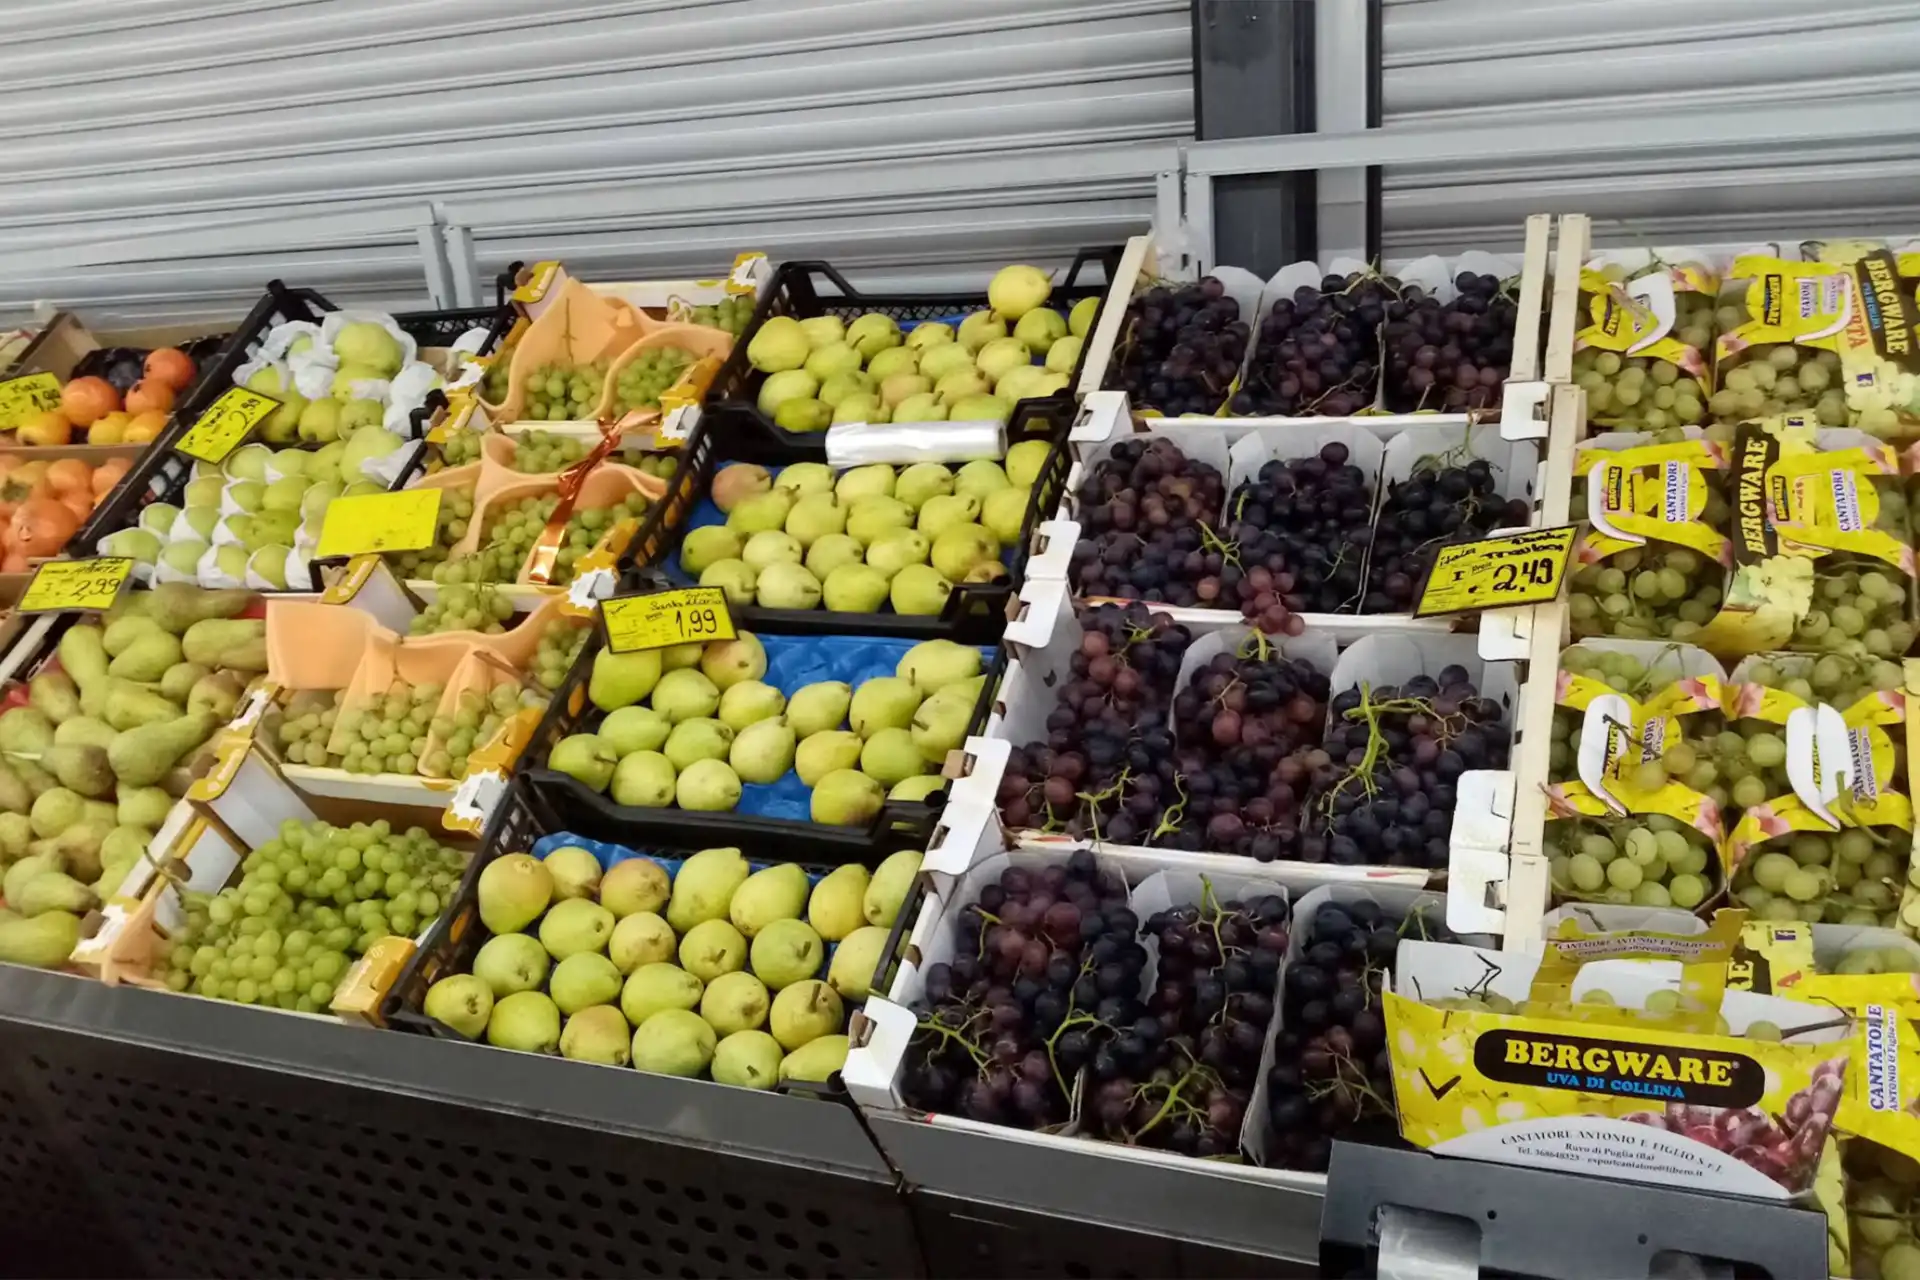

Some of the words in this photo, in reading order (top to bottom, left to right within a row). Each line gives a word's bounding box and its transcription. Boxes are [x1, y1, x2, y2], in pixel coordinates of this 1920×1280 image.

[1864, 259, 1910, 356] BERGWARE
[1666, 461, 1678, 522] CANTATORE
[1740, 439, 1768, 555] BERGWARE
[1832, 471, 1850, 532] CANTATORE
[675, 608, 717, 638] 1,99
[1504, 1038, 1733, 1087] BERGWARE
[1547, 1072, 1580, 1087] UVA
[1586, 1076, 1605, 1090] DI
[1610, 1079, 1685, 1099] COLLINA
[1888, 1065, 1899, 1111] ANTONIO
[1501, 1130, 1573, 1145] CANTATORE
[1579, 1130, 1636, 1145] ANTONIO
[1652, 1141, 1696, 1161] FIGLIO
[1518, 1146, 1532, 1156] Tel.
[1564, 1142, 1590, 1153] Ruvo
[1592, 1146, 1602, 1155] di
[1604, 1148, 1634, 1160] Puglia
[1636, 1151, 1655, 1162] (Ba)
